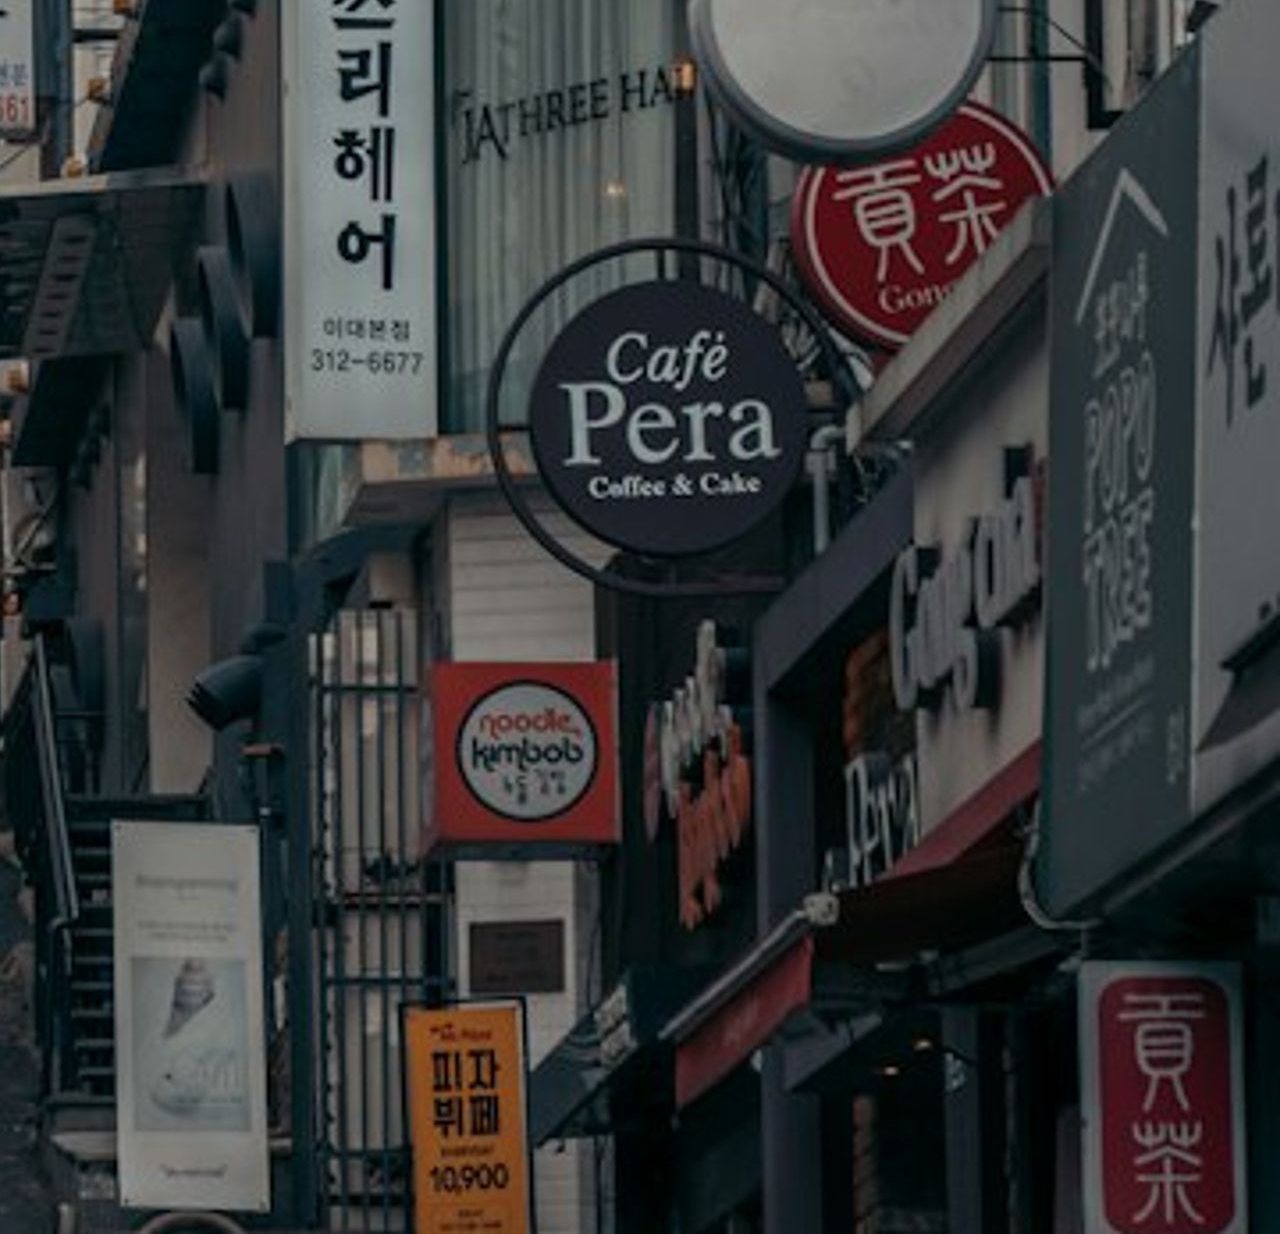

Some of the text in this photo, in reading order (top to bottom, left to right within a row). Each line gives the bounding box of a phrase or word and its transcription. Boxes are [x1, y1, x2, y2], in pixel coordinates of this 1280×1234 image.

[878, 282, 954, 315] Gon
[310, 348, 425, 376] 312-6677
[559, 380, 782, 467] Pera
[589, 471, 761, 500] Coffee & Cake
[480, 707, 582, 741] noodle
[472, 736, 584, 774] kimbob
[1116, 992, 1206, 1224] 貢茶
[429, 1163, 510, 1196] 10,900
